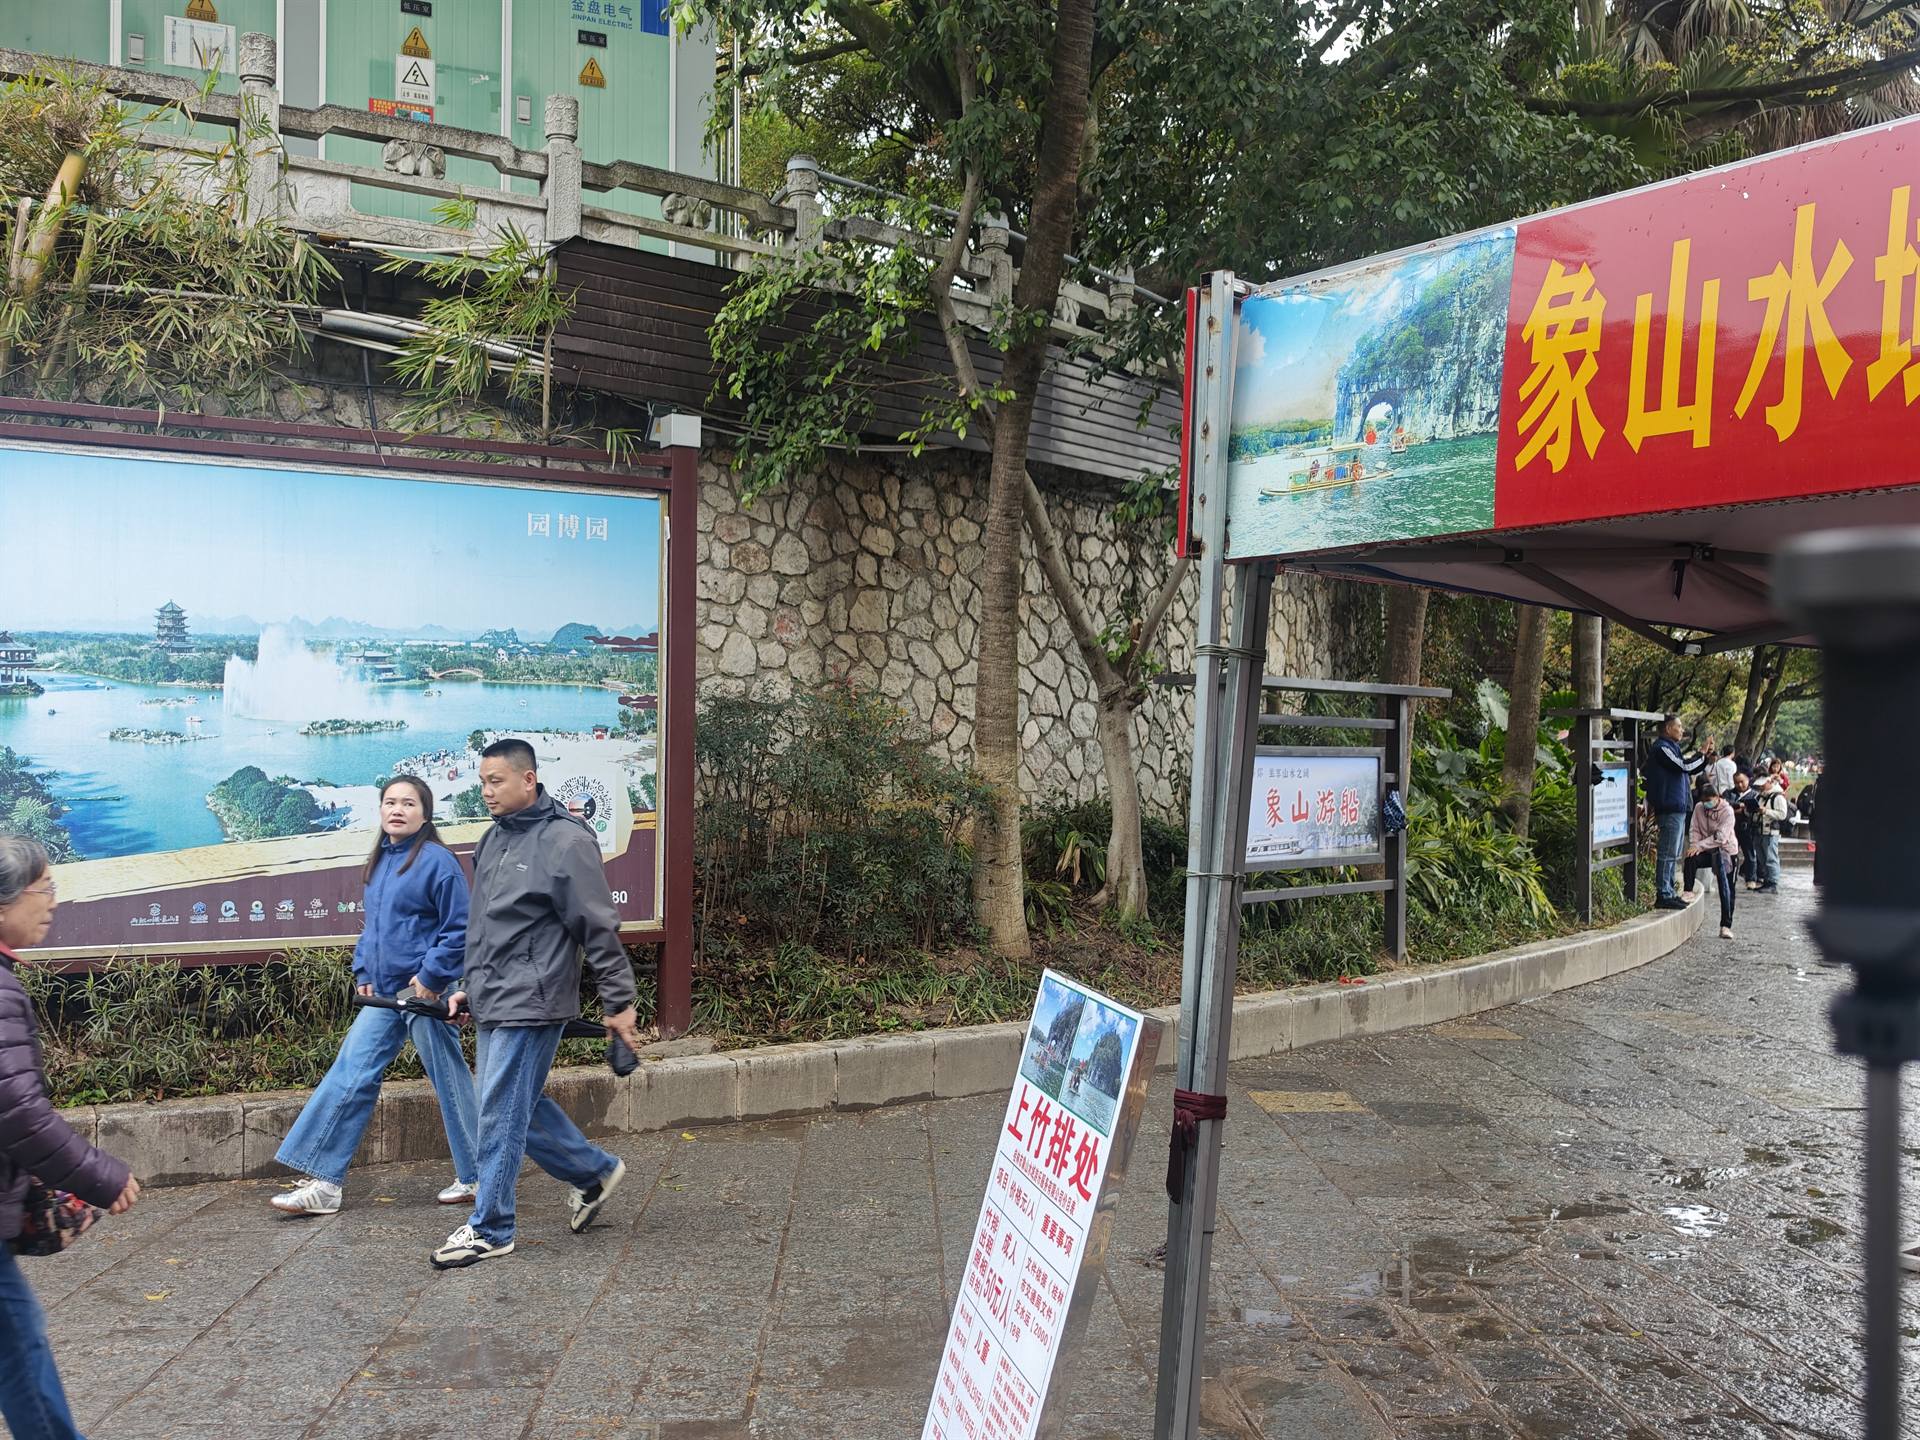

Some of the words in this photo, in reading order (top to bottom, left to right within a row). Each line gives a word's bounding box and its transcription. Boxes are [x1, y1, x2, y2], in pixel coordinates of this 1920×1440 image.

[572, 0, 632, 21] 金盘电气
[572, 14, 596, 23] JINPAN
[598, 18, 632, 29] ELECTRIC
[527, 512, 608, 541] 园博园
[1266, 787, 1359, 828] 象山游船
[1007, 1083, 1099, 1202] 上竹排处
[996, 1167, 1009, 1190] 项目
[1009, 1180, 1036, 1221] 价格元/人
[985, 1207, 999, 1233] 竹排
[1041, 1213, 1074, 1257] 重要事项
[979, 1229, 994, 1256] 出租
[1002, 1232, 1017, 1265] 成人
[973, 1248, 988, 1278] 照相
[983, 1267, 1012, 1329] 50元/人
[1010, 1321, 1021, 1343] 18号
[974, 1330, 990, 1365] 儿童
